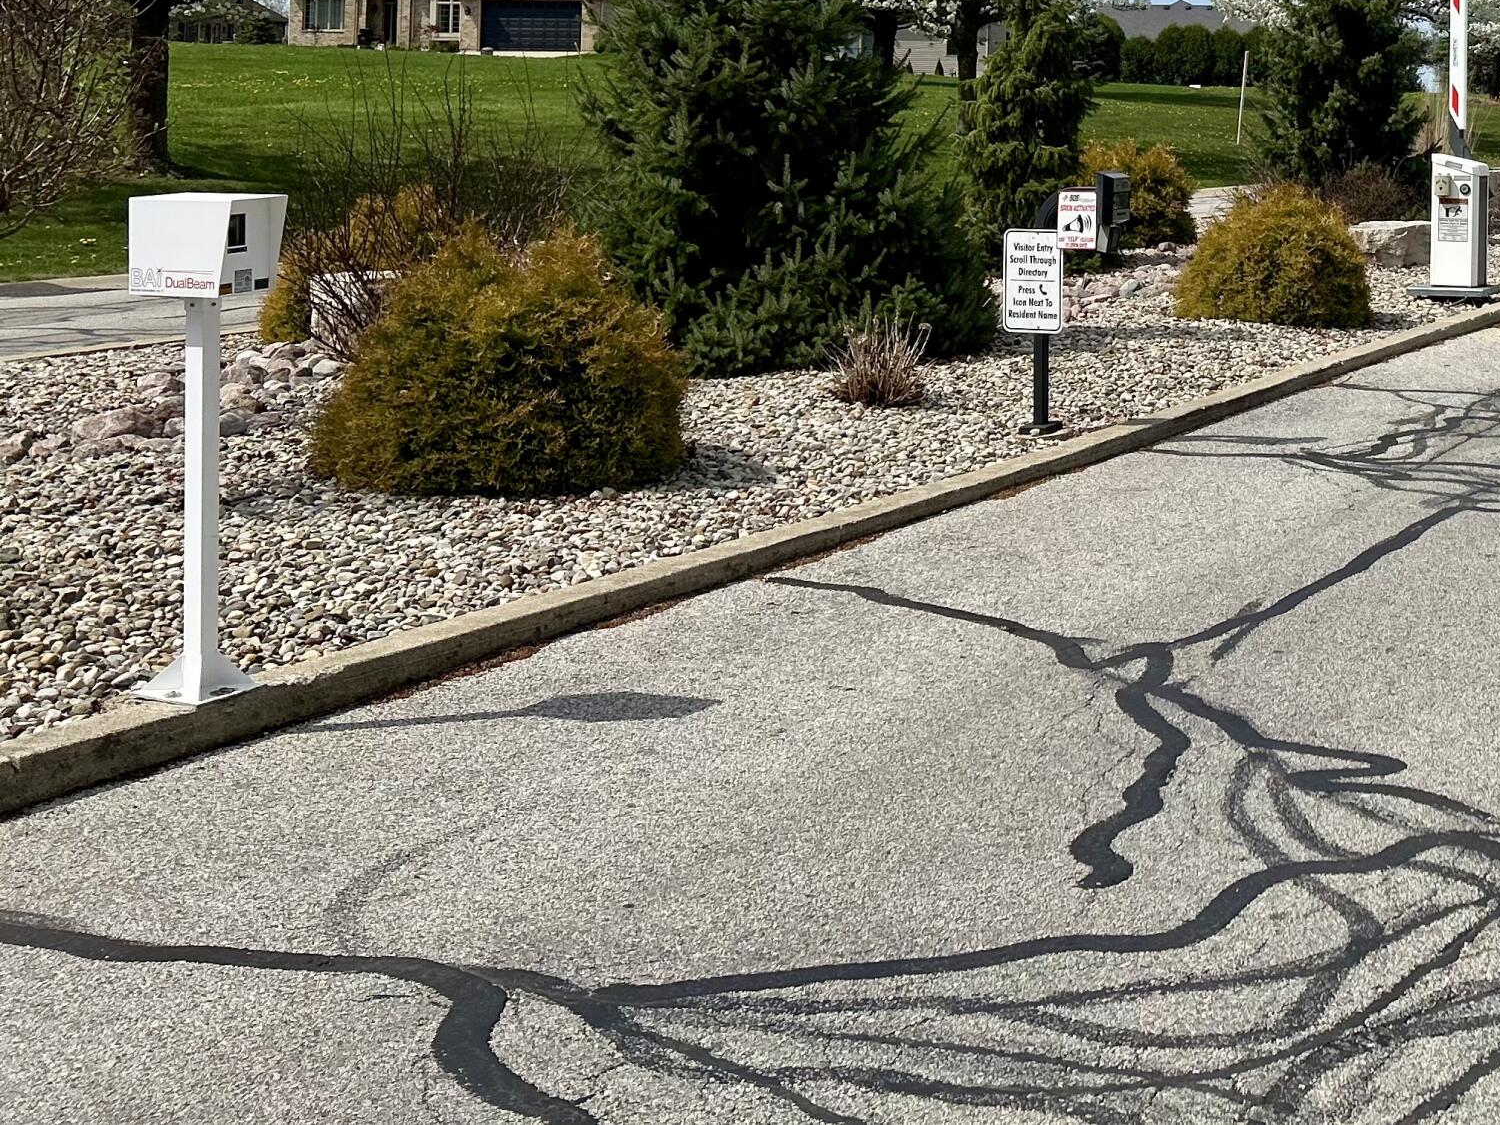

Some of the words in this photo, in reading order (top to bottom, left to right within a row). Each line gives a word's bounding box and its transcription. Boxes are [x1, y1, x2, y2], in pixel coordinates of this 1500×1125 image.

[1013, 242, 1035, 252] Visitor
[1036, 242, 1053, 254] Entry
[1010, 254, 1028, 264] Scroll
[1029, 254, 1057, 267] Through
[1018, 267, 1048, 278] Directory
[165, 276, 215, 290] DualBeam
[1018, 285, 1036, 294] Press
[1013, 297, 1027, 306] Icon
[1028, 297, 1044, 307] Next
[1044, 298, 1053, 307] To
[1008, 309, 1037, 319] Resident
[1038, 310, 1058, 319] Name
